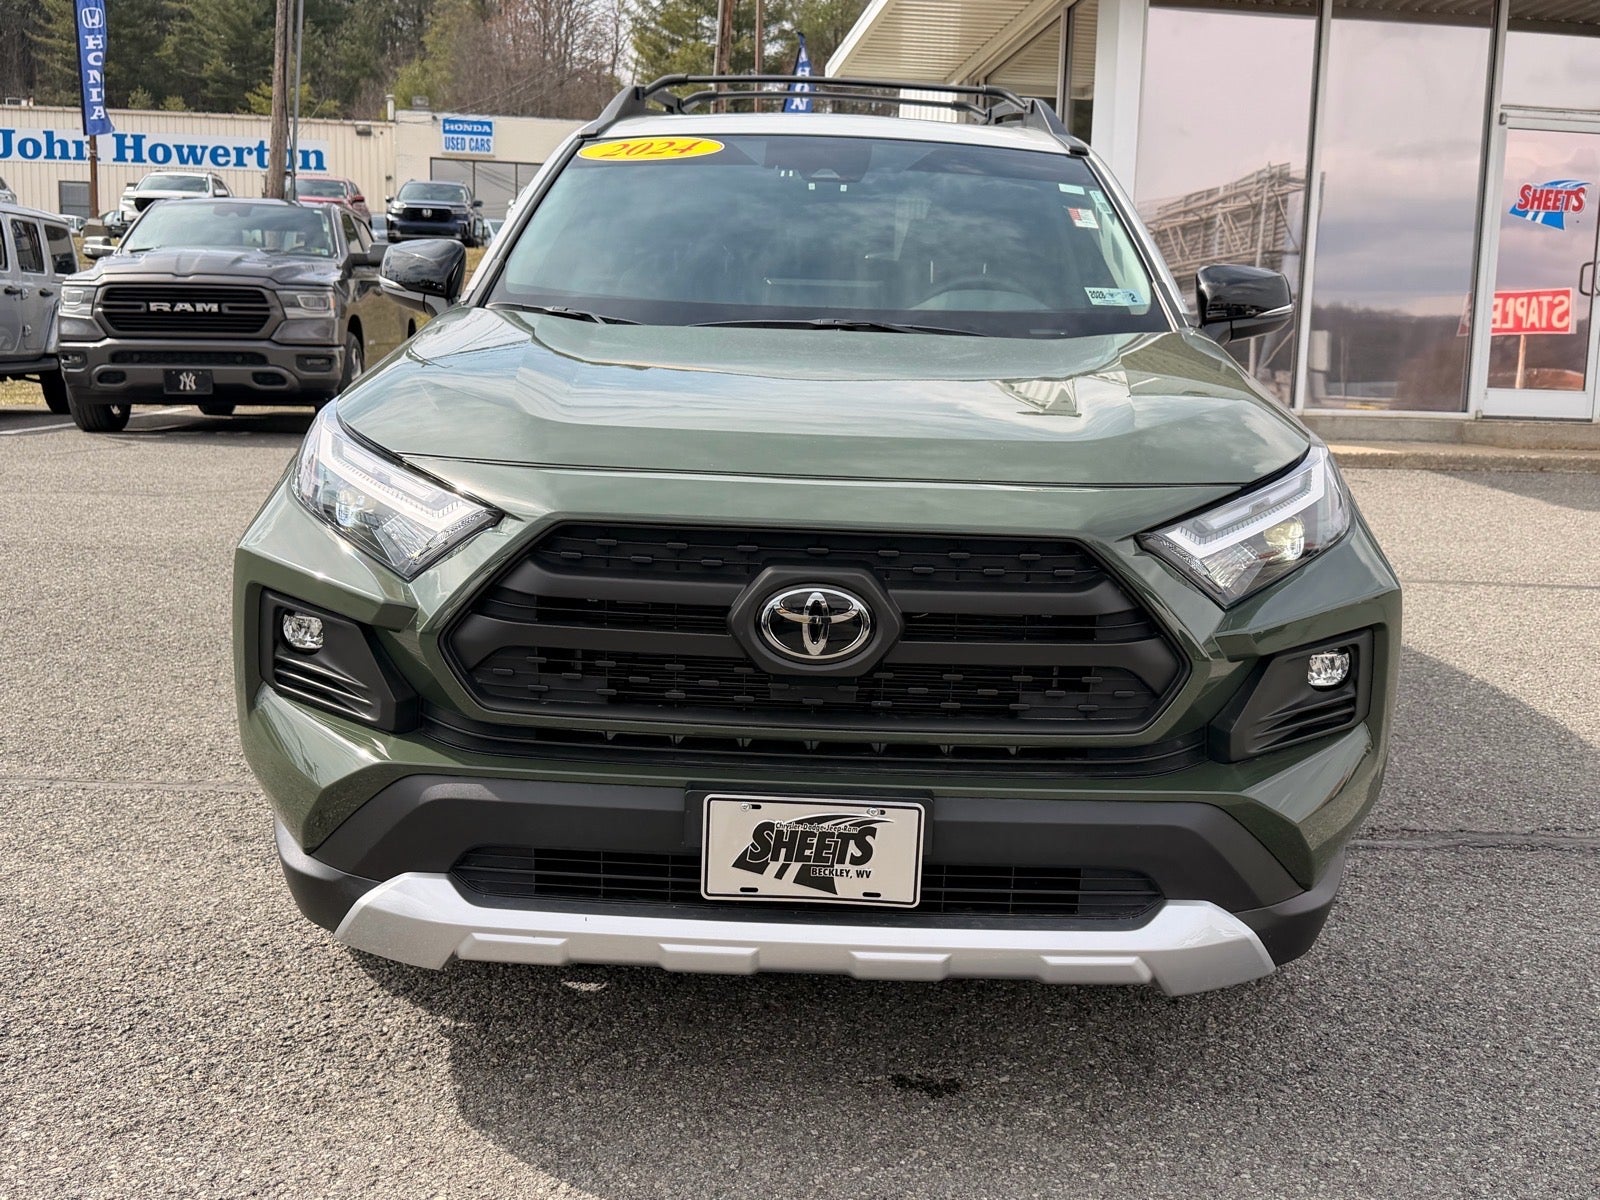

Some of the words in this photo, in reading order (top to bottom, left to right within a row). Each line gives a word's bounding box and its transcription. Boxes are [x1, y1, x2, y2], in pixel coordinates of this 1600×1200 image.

[444, 122, 492, 133] HONDA
[0, 129, 101, 161] John
[112, 133, 327, 171] Howertn
[445, 136, 466, 151] USED
[469, 137, 491, 153] CARS
[599, 141, 703, 158] 2024
[1516, 184, 1586, 213] SHEETS
[149, 302, 219, 313] RAM
[748, 821, 878, 867] SHEETS
[811, 867, 853, 879] BECKLEY,
[856, 869, 872, 879] WV
